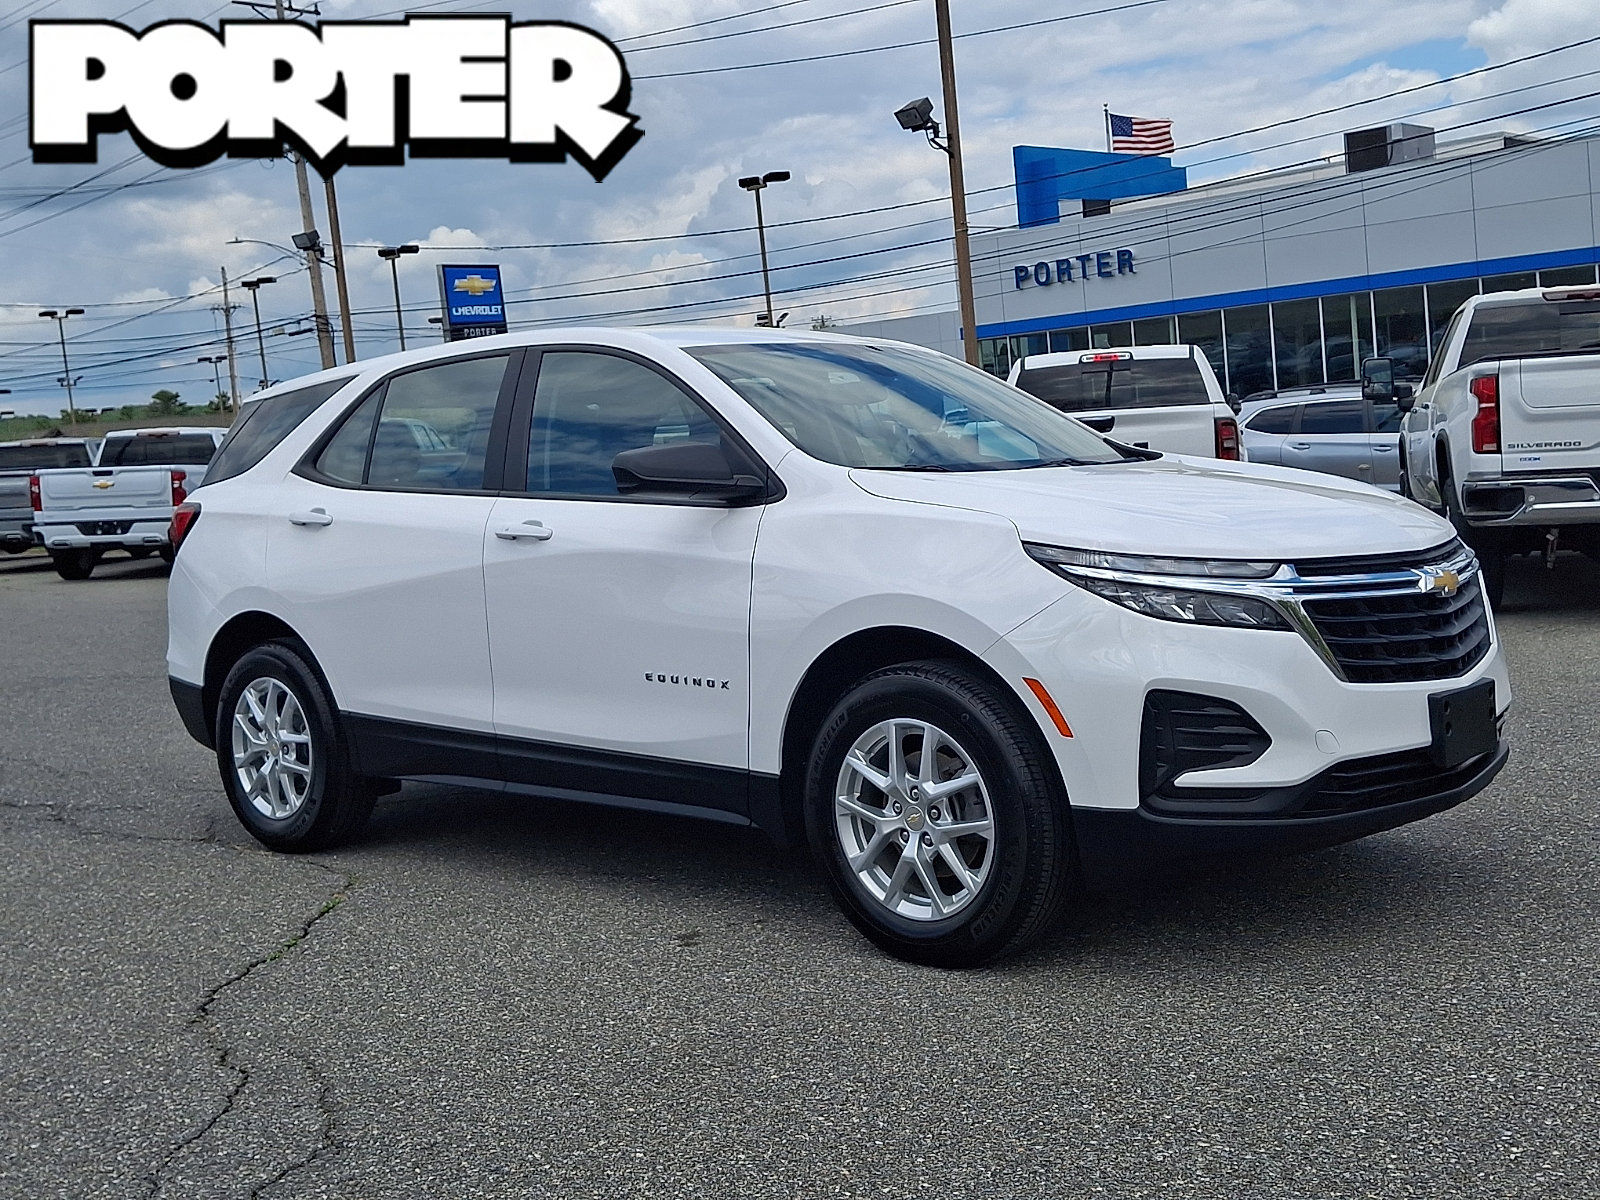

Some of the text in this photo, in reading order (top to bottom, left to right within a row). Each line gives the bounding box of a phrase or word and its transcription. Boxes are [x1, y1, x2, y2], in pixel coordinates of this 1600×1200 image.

[1014, 249, 1137, 290] PORTER
[452, 305, 502, 316] CHEVROLET
[464, 327, 497, 338] PORTER
[1507, 441, 1582, 449] SILVERADO
[644, 672, 730, 690] EQUINOX
